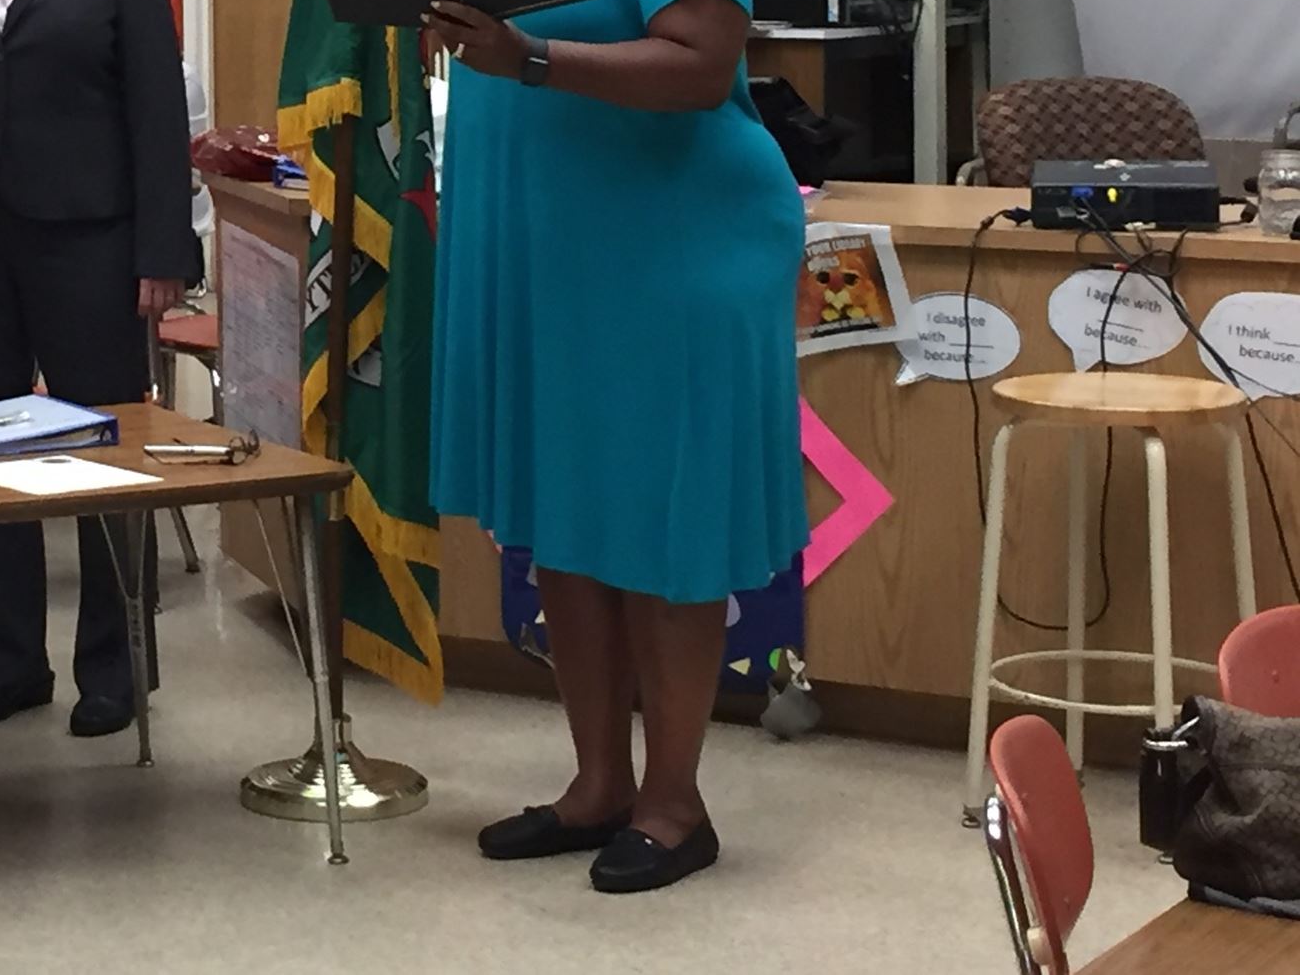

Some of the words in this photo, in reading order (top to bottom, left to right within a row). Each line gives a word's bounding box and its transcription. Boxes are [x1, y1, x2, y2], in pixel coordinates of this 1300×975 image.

[1086, 286, 1091, 297] I
[1093, 289, 1130, 307] agee
[1133, 298, 1162, 313] with
[933, 311, 986, 328] disagee
[918, 330, 946, 342] with
[1228, 324, 1233, 335] I
[1236, 325, 1271, 341] think
